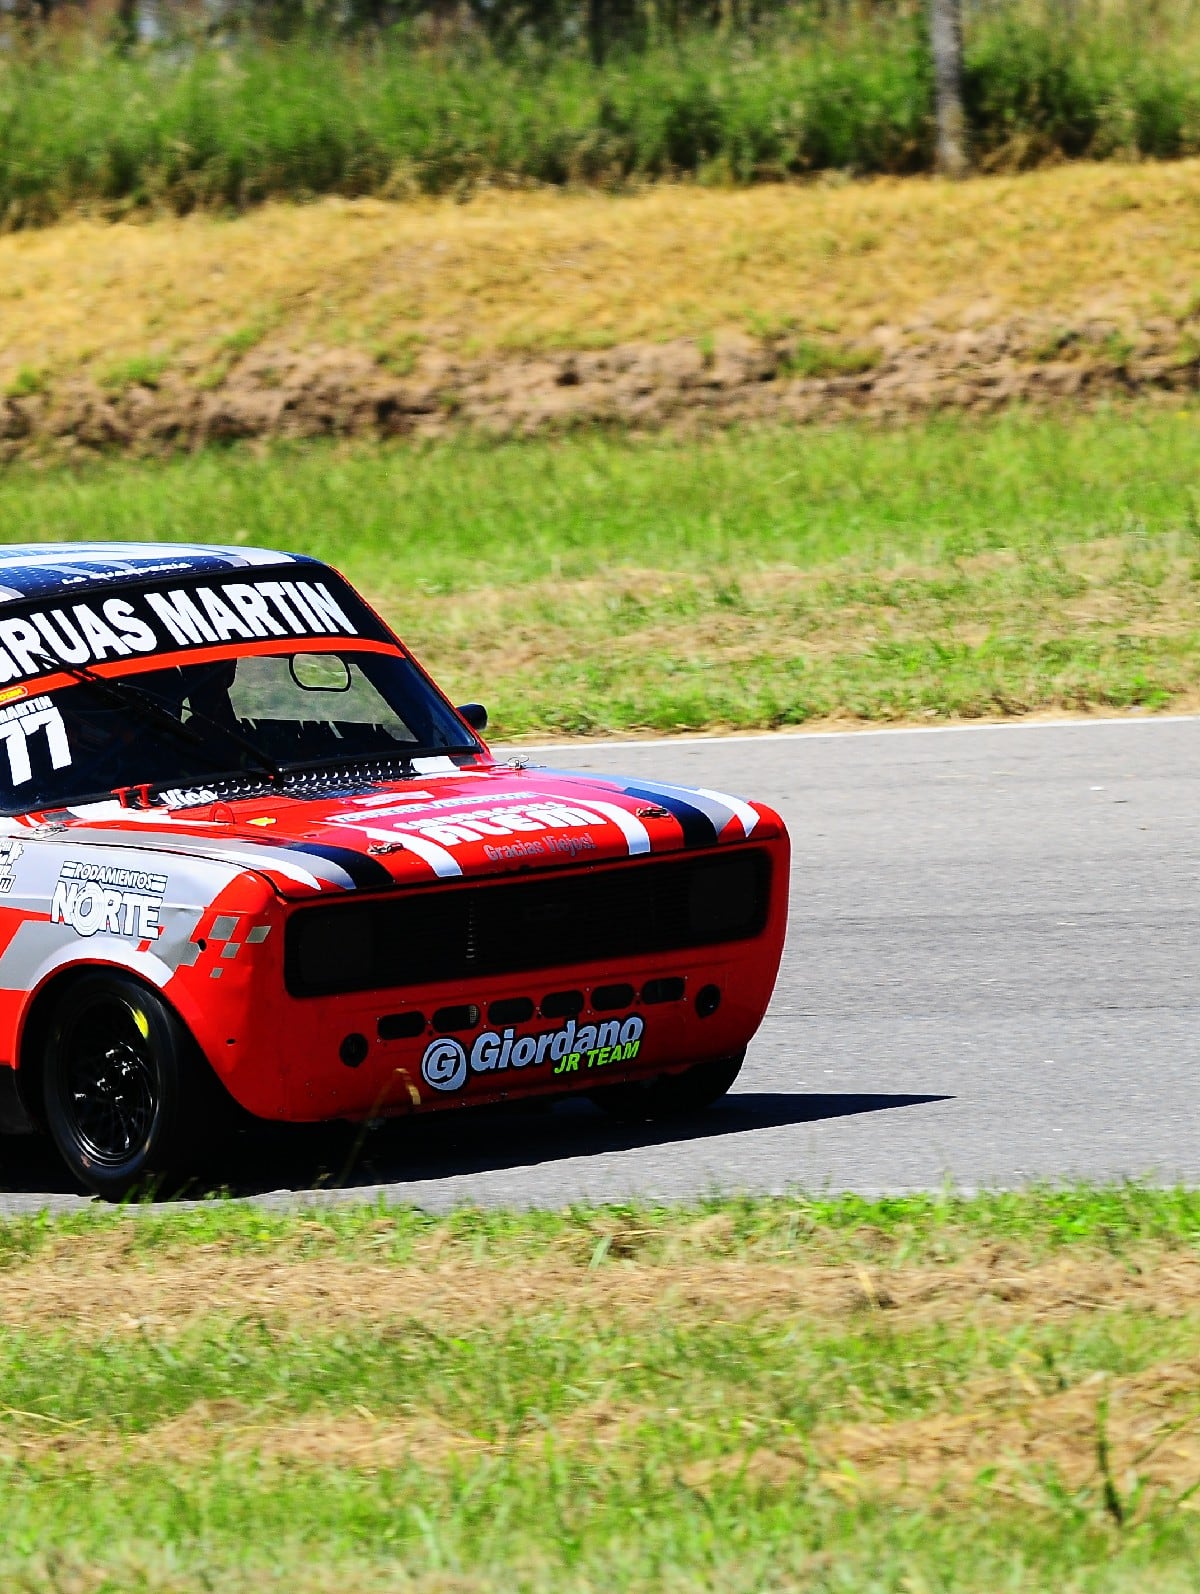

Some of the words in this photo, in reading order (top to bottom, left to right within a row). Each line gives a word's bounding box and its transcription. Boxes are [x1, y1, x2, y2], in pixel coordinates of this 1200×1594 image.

[145, 581, 358, 646] MARTIN
[418, 807, 607, 846] ALEM
[483, 839, 544, 861] Gracias
[541, 833, 597, 857] Viejos!
[73, 863, 154, 890] RODAMIENTOS
[50, 879, 163, 941] NORTE
[470, 1015, 643, 1071] Giordano
[553, 1052, 580, 1074] JR
[586, 1041, 640, 1071] TEAM
